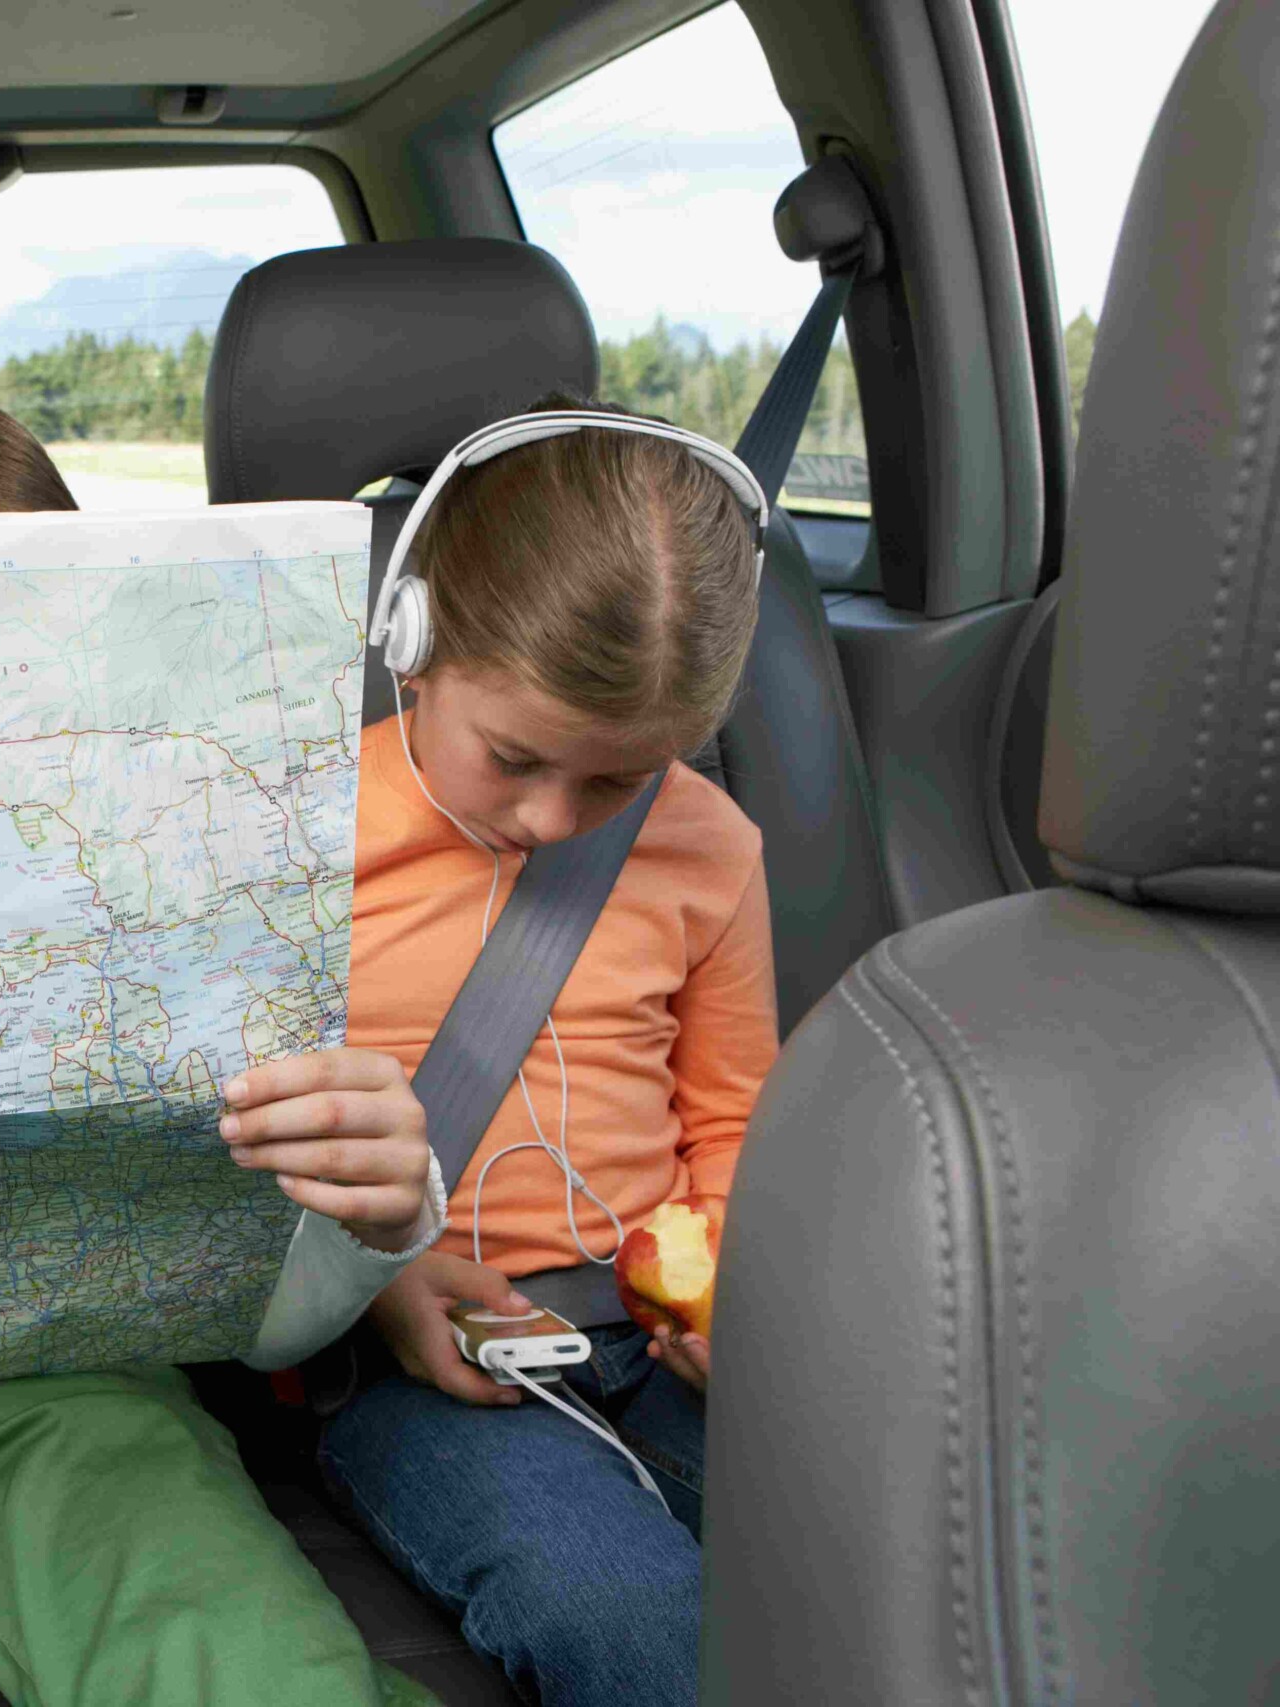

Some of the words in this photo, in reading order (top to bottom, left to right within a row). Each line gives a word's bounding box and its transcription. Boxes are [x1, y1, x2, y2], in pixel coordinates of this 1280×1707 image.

[129, 556, 140, 564] 16
[235, 685, 285, 704] CANADIAN
[282, 696, 316, 713] SHIELD
[185, 776, 209, 785] Timmins
[226, 881, 255, 891] SUDBURY
[128, 911, 144, 921] MARIE
[299, 1010, 332, 1027] MARKHAM
[277, 1024, 312, 1042] BRAMPTON
[263, 1040, 297, 1060] KITCHENER
